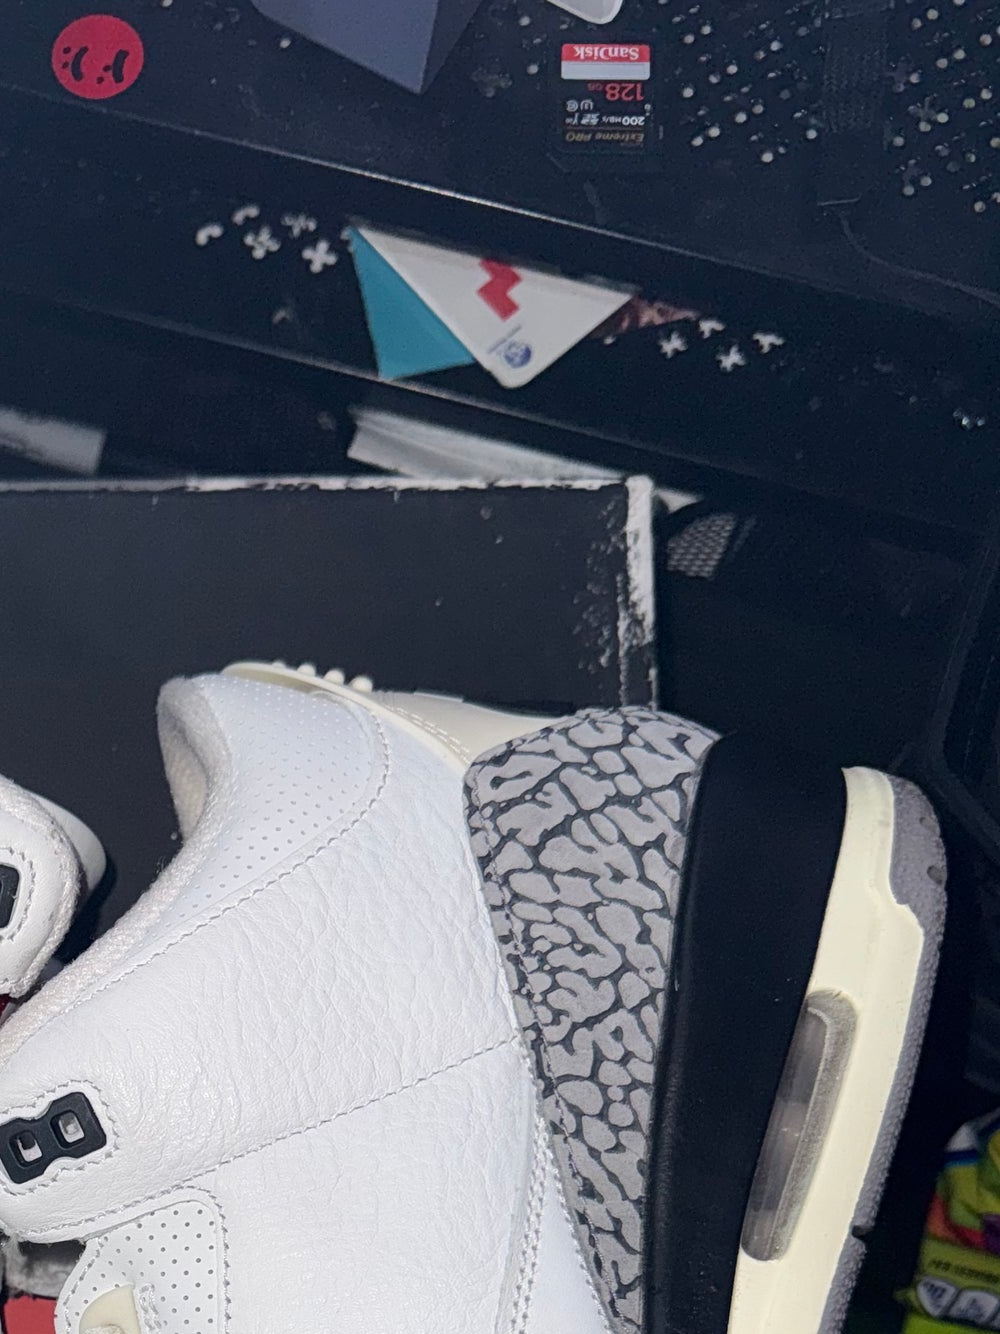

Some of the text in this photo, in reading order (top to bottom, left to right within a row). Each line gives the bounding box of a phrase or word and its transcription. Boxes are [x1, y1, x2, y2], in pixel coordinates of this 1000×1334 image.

[573, 46, 640, 60] SanDisk
[605, 82, 645, 101] 128
[565, 131, 644, 142] Extreme PRO
